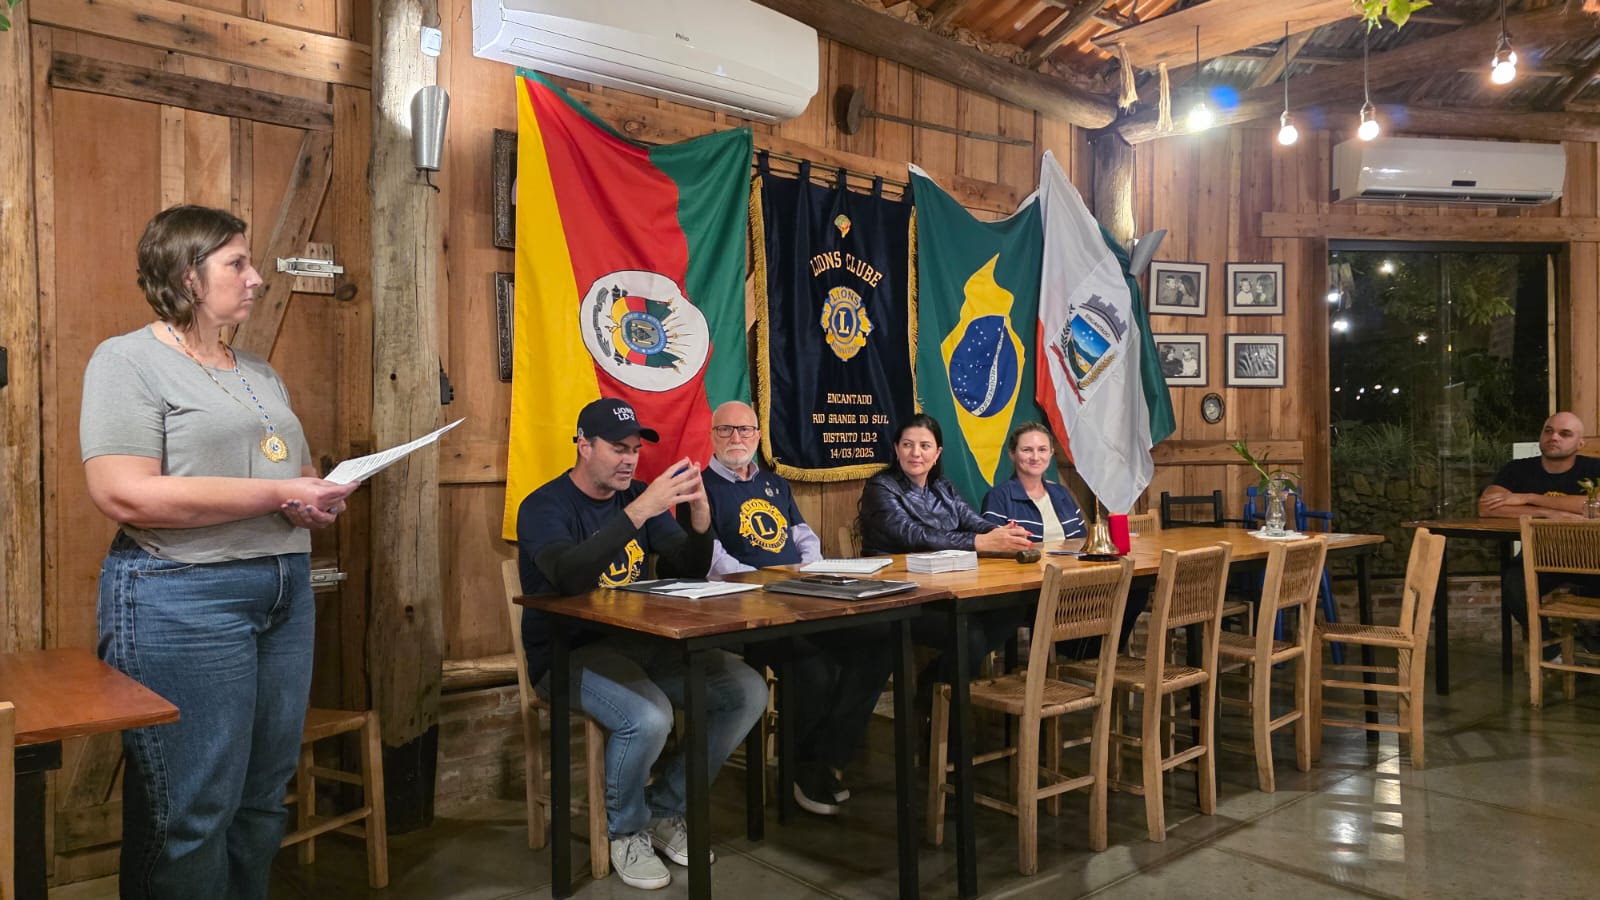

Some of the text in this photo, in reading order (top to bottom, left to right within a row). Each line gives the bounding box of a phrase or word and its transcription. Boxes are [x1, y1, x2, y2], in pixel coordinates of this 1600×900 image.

[809, 250, 883, 288] LIONS CLUBE
[829, 289, 861, 307] LIONS
[838, 310, 850, 334] L
[827, 393, 873, 405] ENCANTADO
[812, 413, 889, 425] RIO GRANDE DO SUL
[823, 432, 878, 443] DISTRITO LD-2
[830, 447, 875, 459] 14/03/2025
[743, 501, 770, 513] LIONS
[753, 515, 775, 536] L
